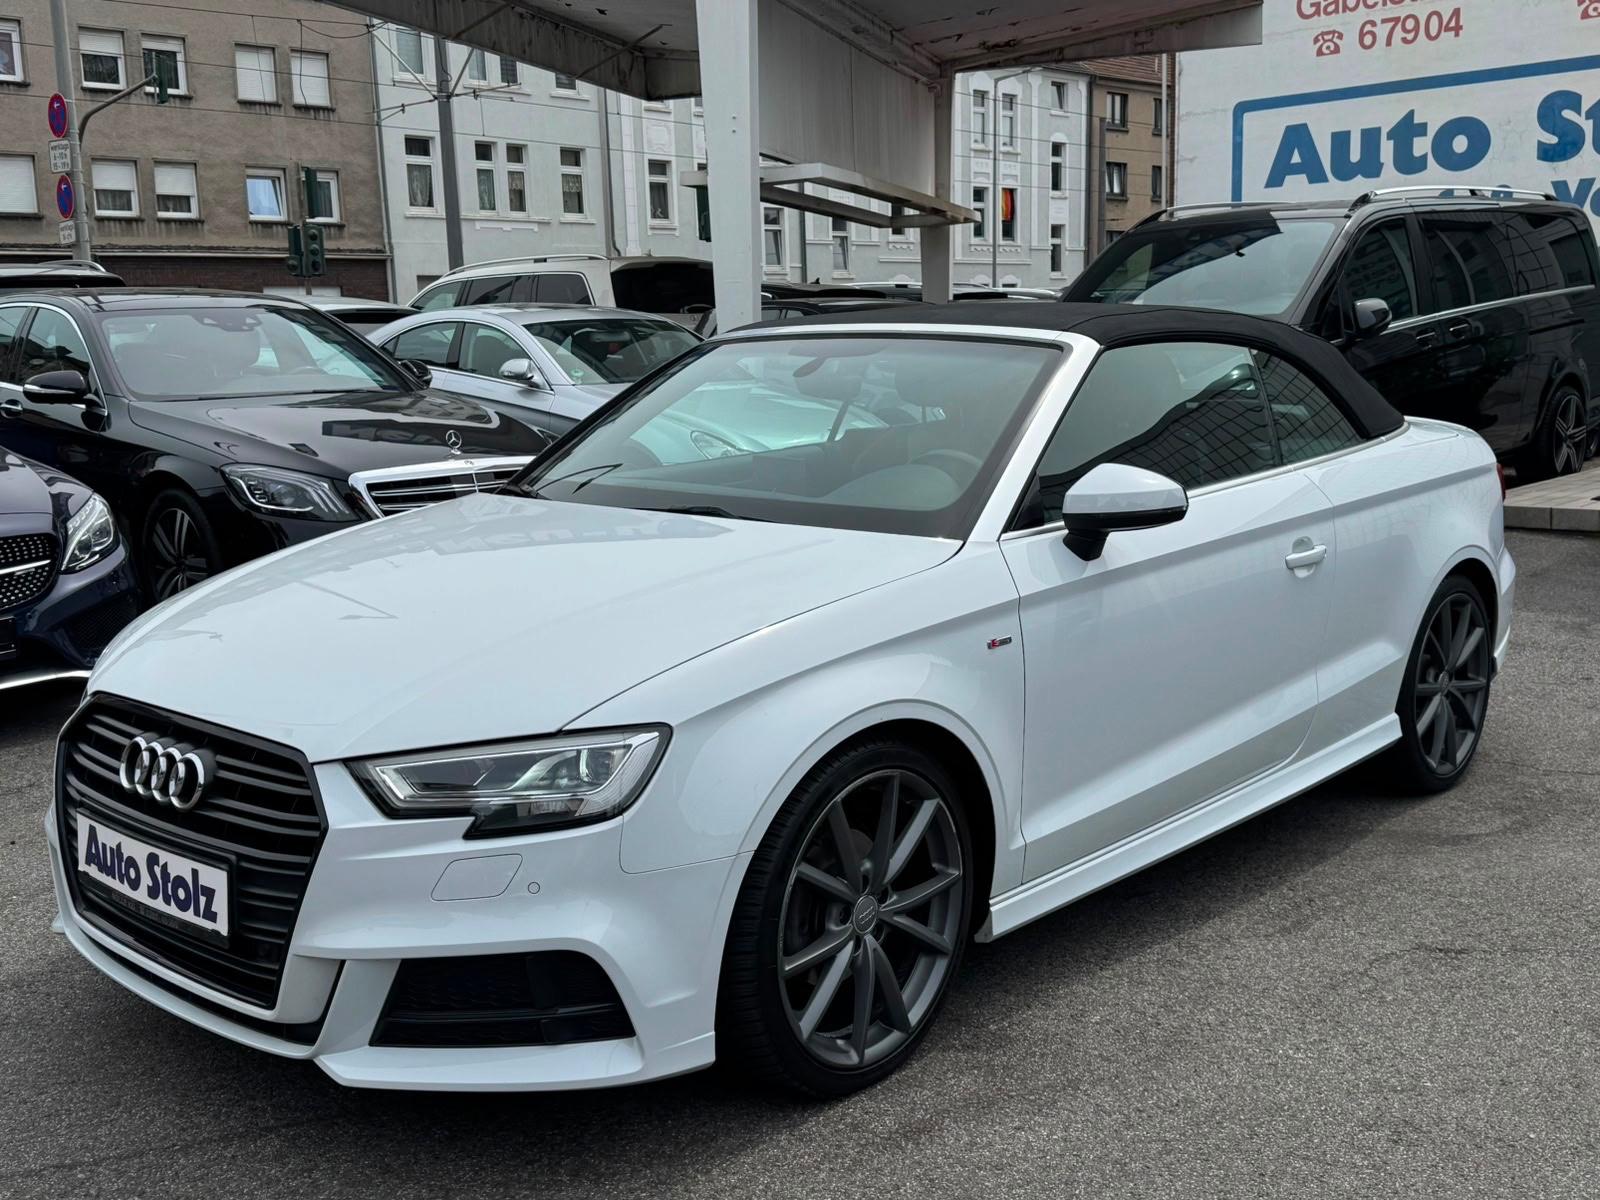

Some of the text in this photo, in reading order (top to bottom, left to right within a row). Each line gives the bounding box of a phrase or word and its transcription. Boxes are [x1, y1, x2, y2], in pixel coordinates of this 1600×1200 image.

[1359, 8, 1463, 50] 67904
[1264, 109, 1491, 188] Auto
[85, 824, 141, 891] Auto
[146, 852, 217, 924] Stolz
